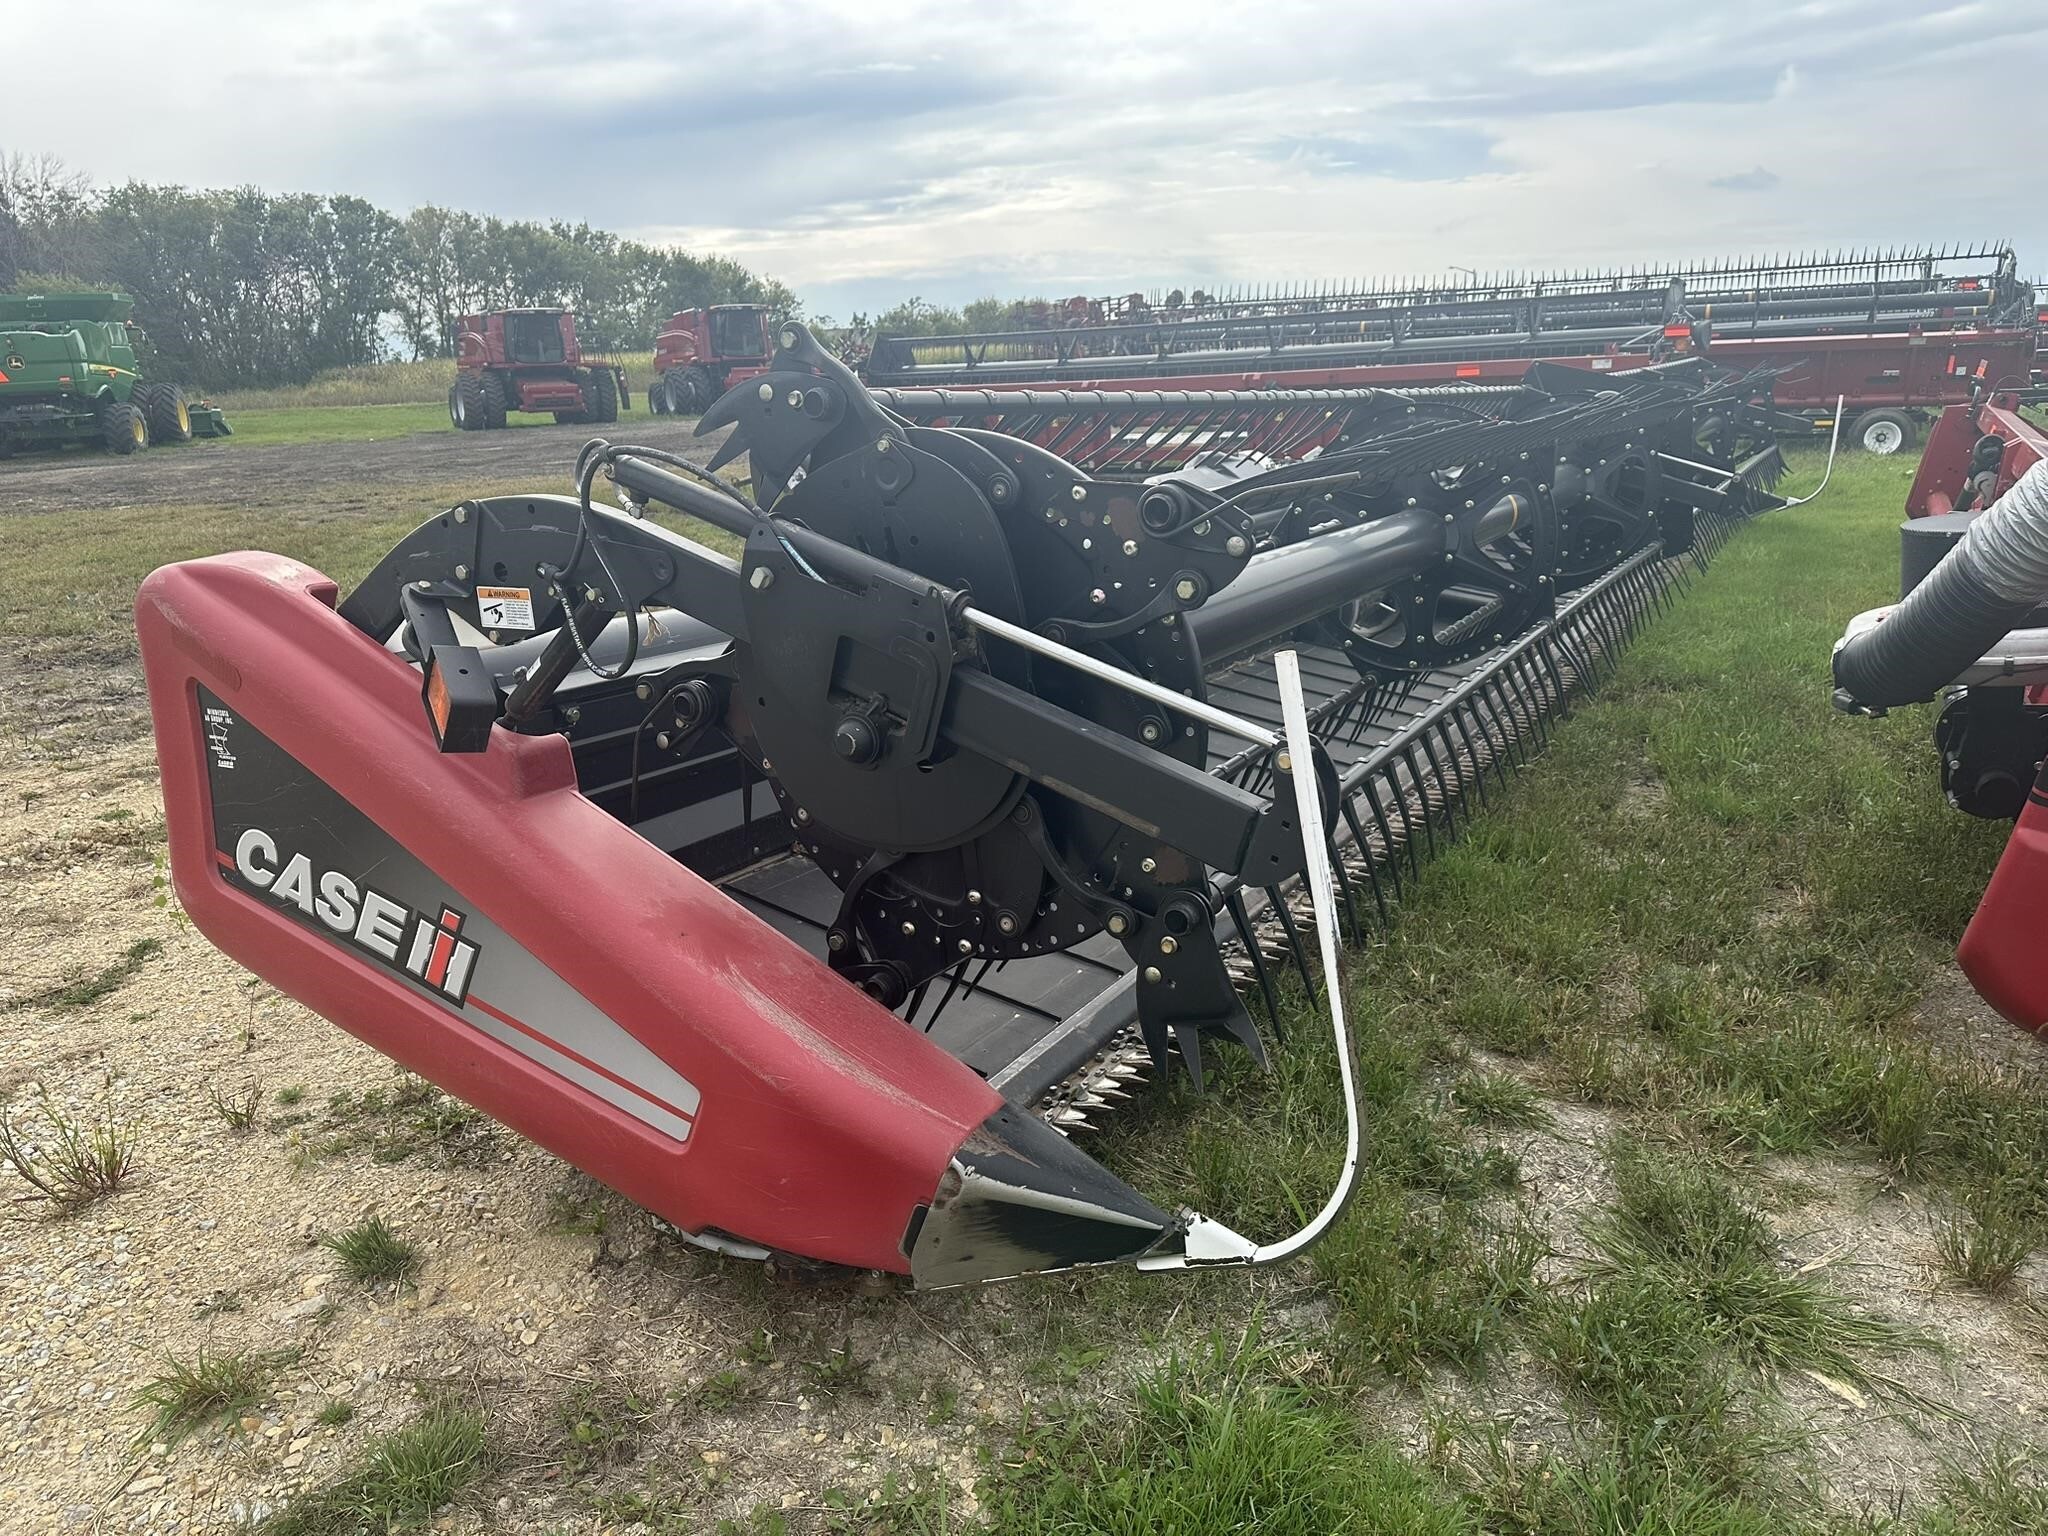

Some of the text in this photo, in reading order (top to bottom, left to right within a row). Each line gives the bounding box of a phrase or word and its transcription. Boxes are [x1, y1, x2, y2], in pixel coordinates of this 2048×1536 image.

[493, 590, 520, 599] WARNING
[568, 618, 584, 650] RESISTANT
[235, 828, 408, 961] CASE
